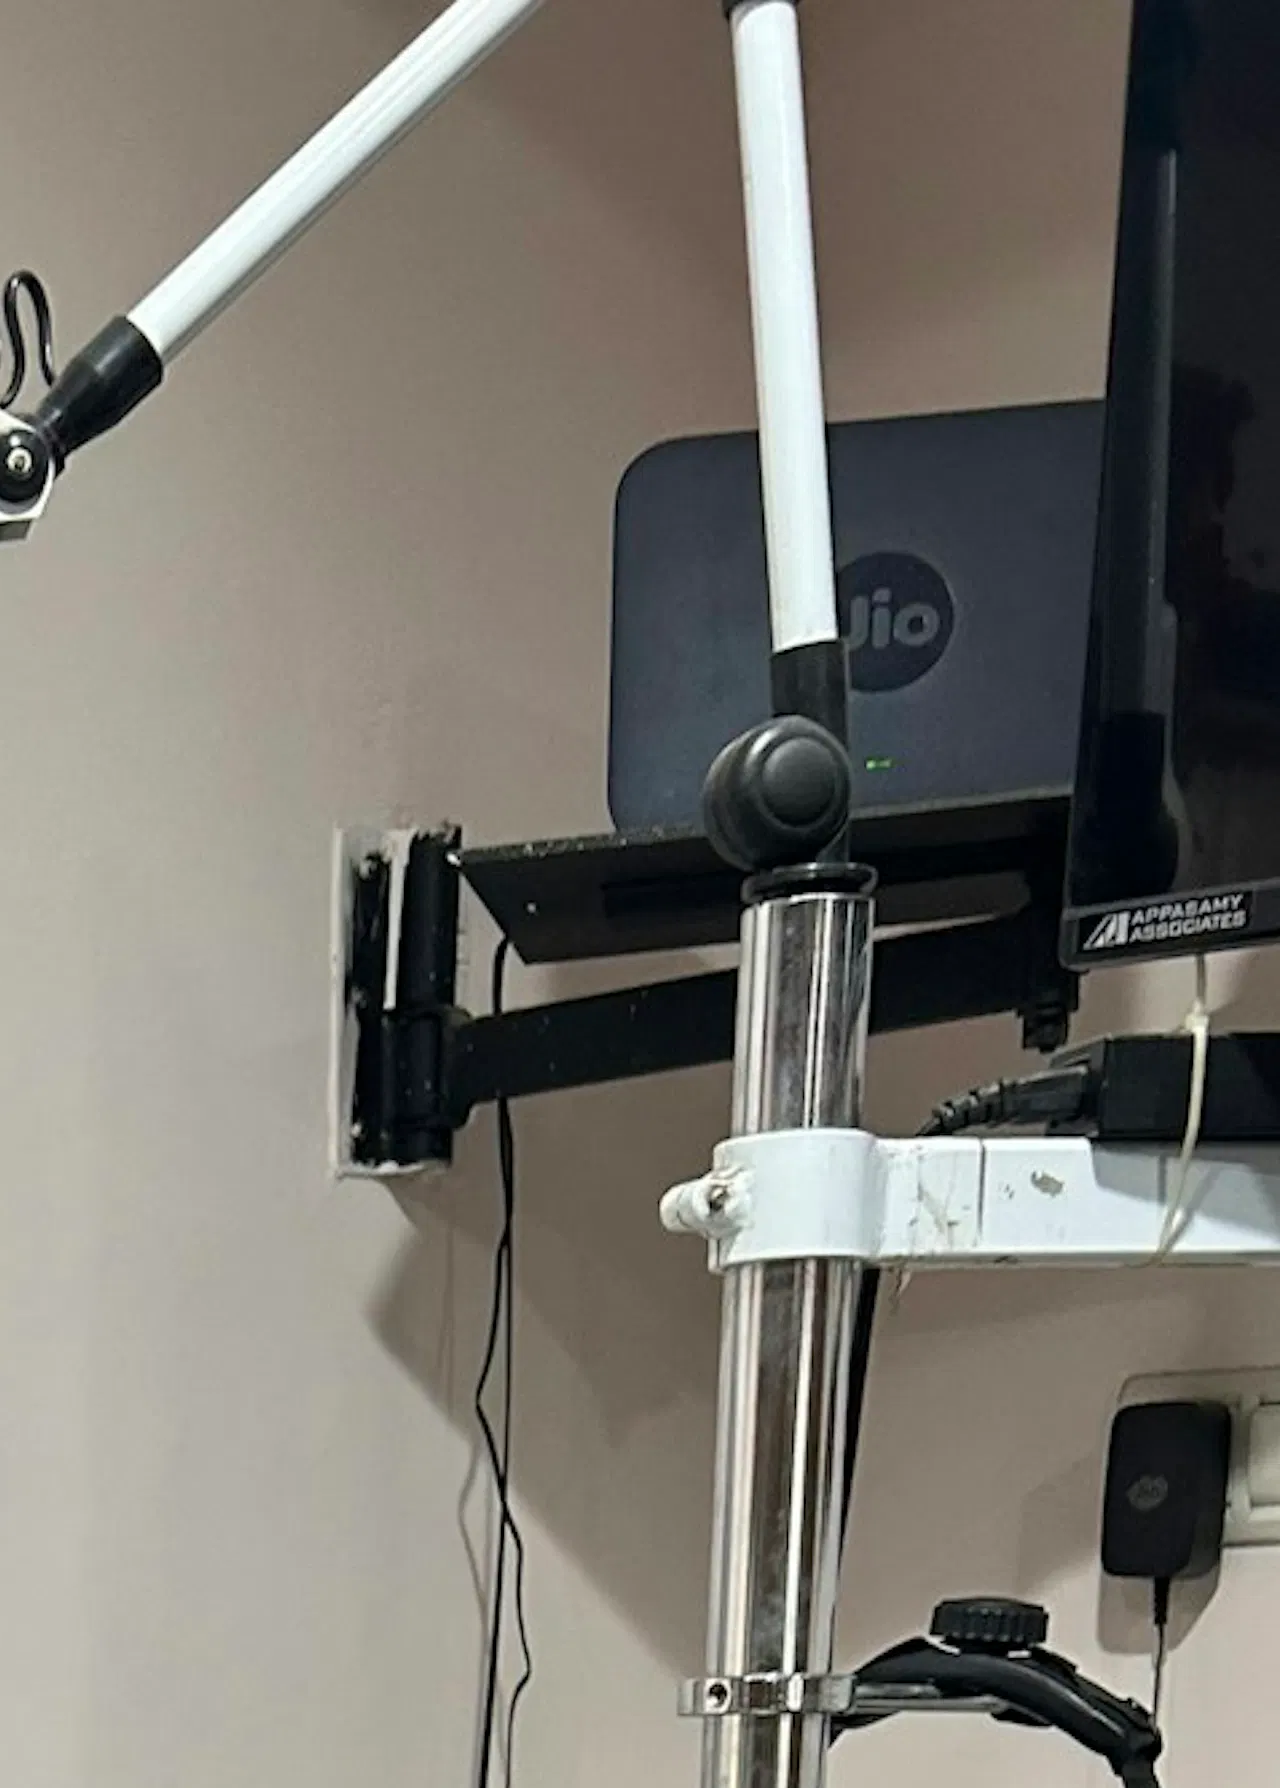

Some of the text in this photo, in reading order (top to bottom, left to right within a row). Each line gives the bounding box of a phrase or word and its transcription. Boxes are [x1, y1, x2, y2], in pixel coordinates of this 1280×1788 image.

[839, 586, 940, 650] Jio
[1128, 909, 1247, 944] ASSOCIATES
[1130, 893, 1244, 926] APPASAMY
